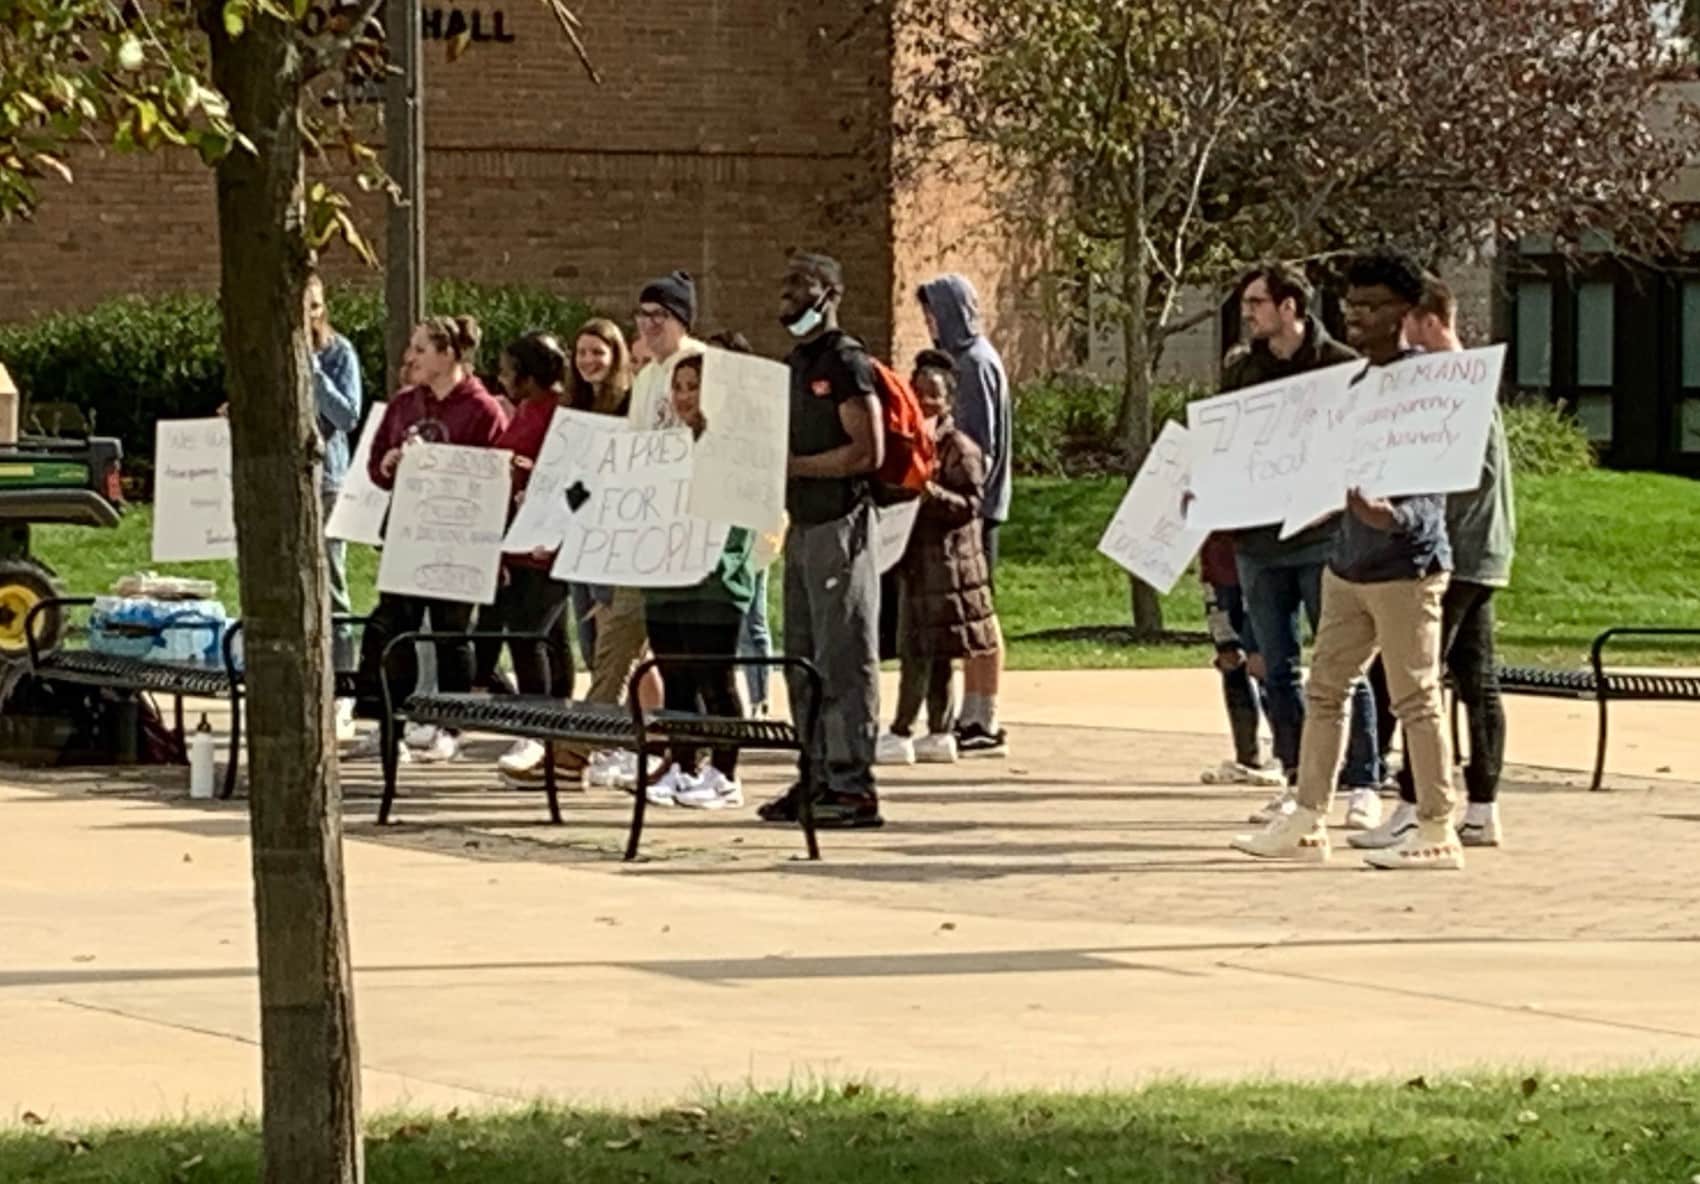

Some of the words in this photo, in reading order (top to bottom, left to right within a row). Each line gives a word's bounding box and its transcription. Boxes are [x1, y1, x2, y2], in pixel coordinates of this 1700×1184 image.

[421, 8, 515, 42] HALL
[1379, 358, 1488, 395] DEMAND
[597, 436, 617, 475] A
[597, 485, 662, 527] FOR
